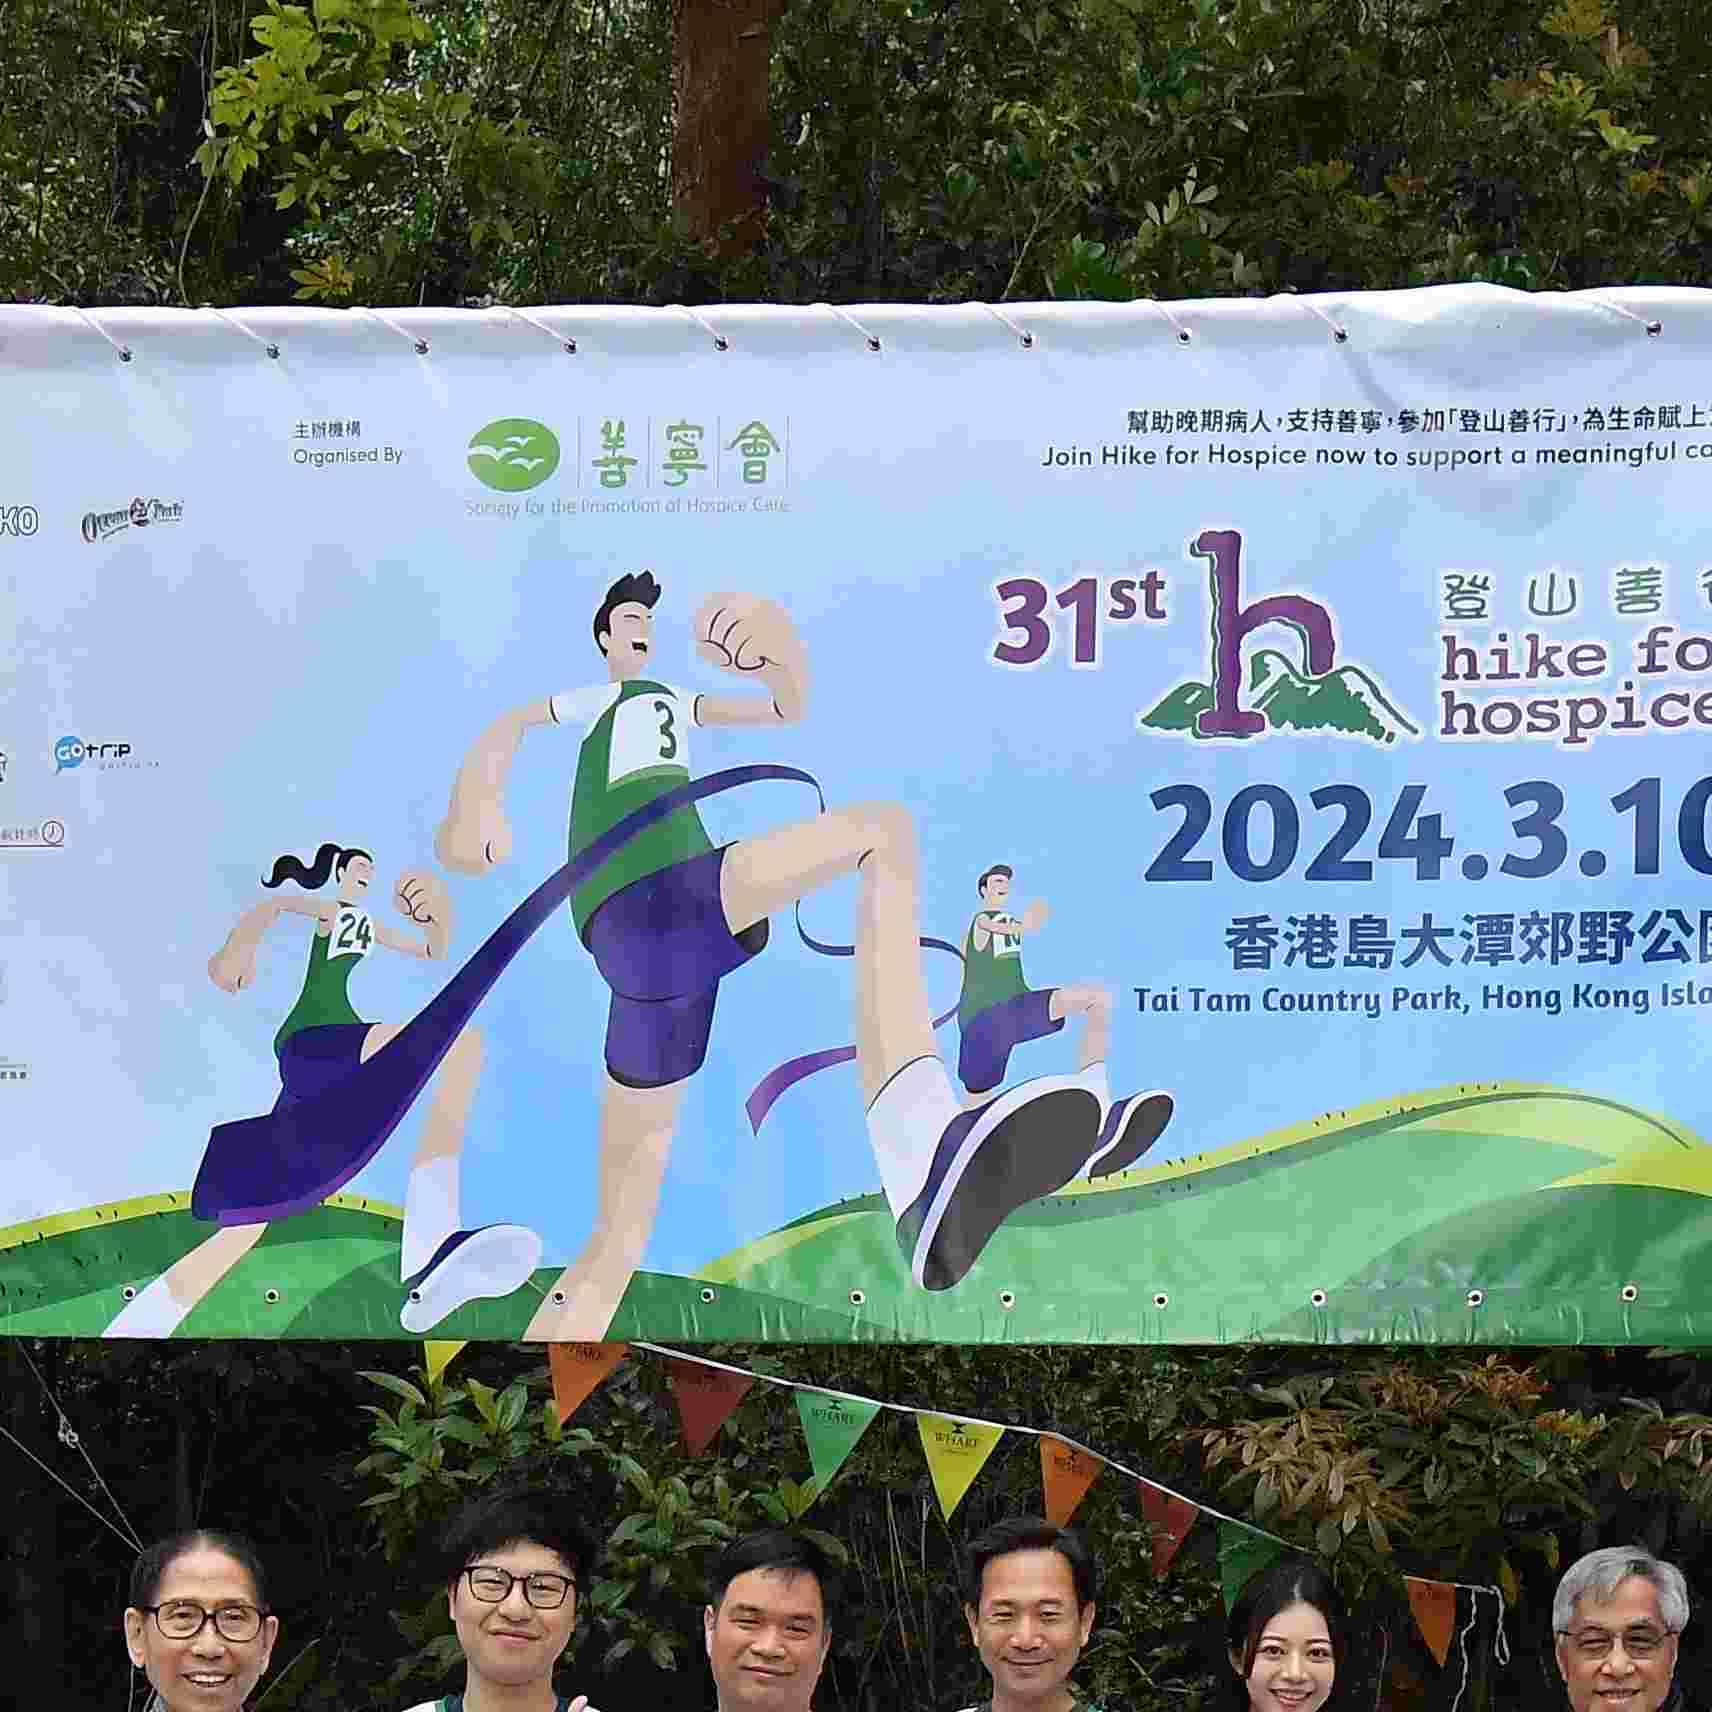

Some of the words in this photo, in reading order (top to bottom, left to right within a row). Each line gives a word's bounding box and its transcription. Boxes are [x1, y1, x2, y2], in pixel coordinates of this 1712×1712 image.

[293, 447, 379, 467] Organised
[383, 446, 404, 464] By
[1042, 446, 1092, 467] Join
[1101, 445, 1157, 465] Hike
[1166, 444, 1200, 465] for
[1209, 443, 1307, 471] Hospice
[1316, 449, 1366, 465] now
[1375, 446, 1398, 466] to
[1407, 446, 1503, 471] support
[1511, 450, 1526, 465] a
[1536, 440, 1677, 468] meaningful
[992, 568, 1168, 667] 31st
[1441, 632, 1607, 682] hike
[654, 700, 677, 759] 3
[336, 912, 372, 950] 24
[1133, 987, 1181, 1013] Tai
[1188, 987, 1252, 1013] Tam
[1262, 986, 1382, 1018] Country
[1391, 984, 1471, 1015] Park,
[1481, 983, 1563, 1016] Hong
[1572, 982, 1651, 1014] Kong
